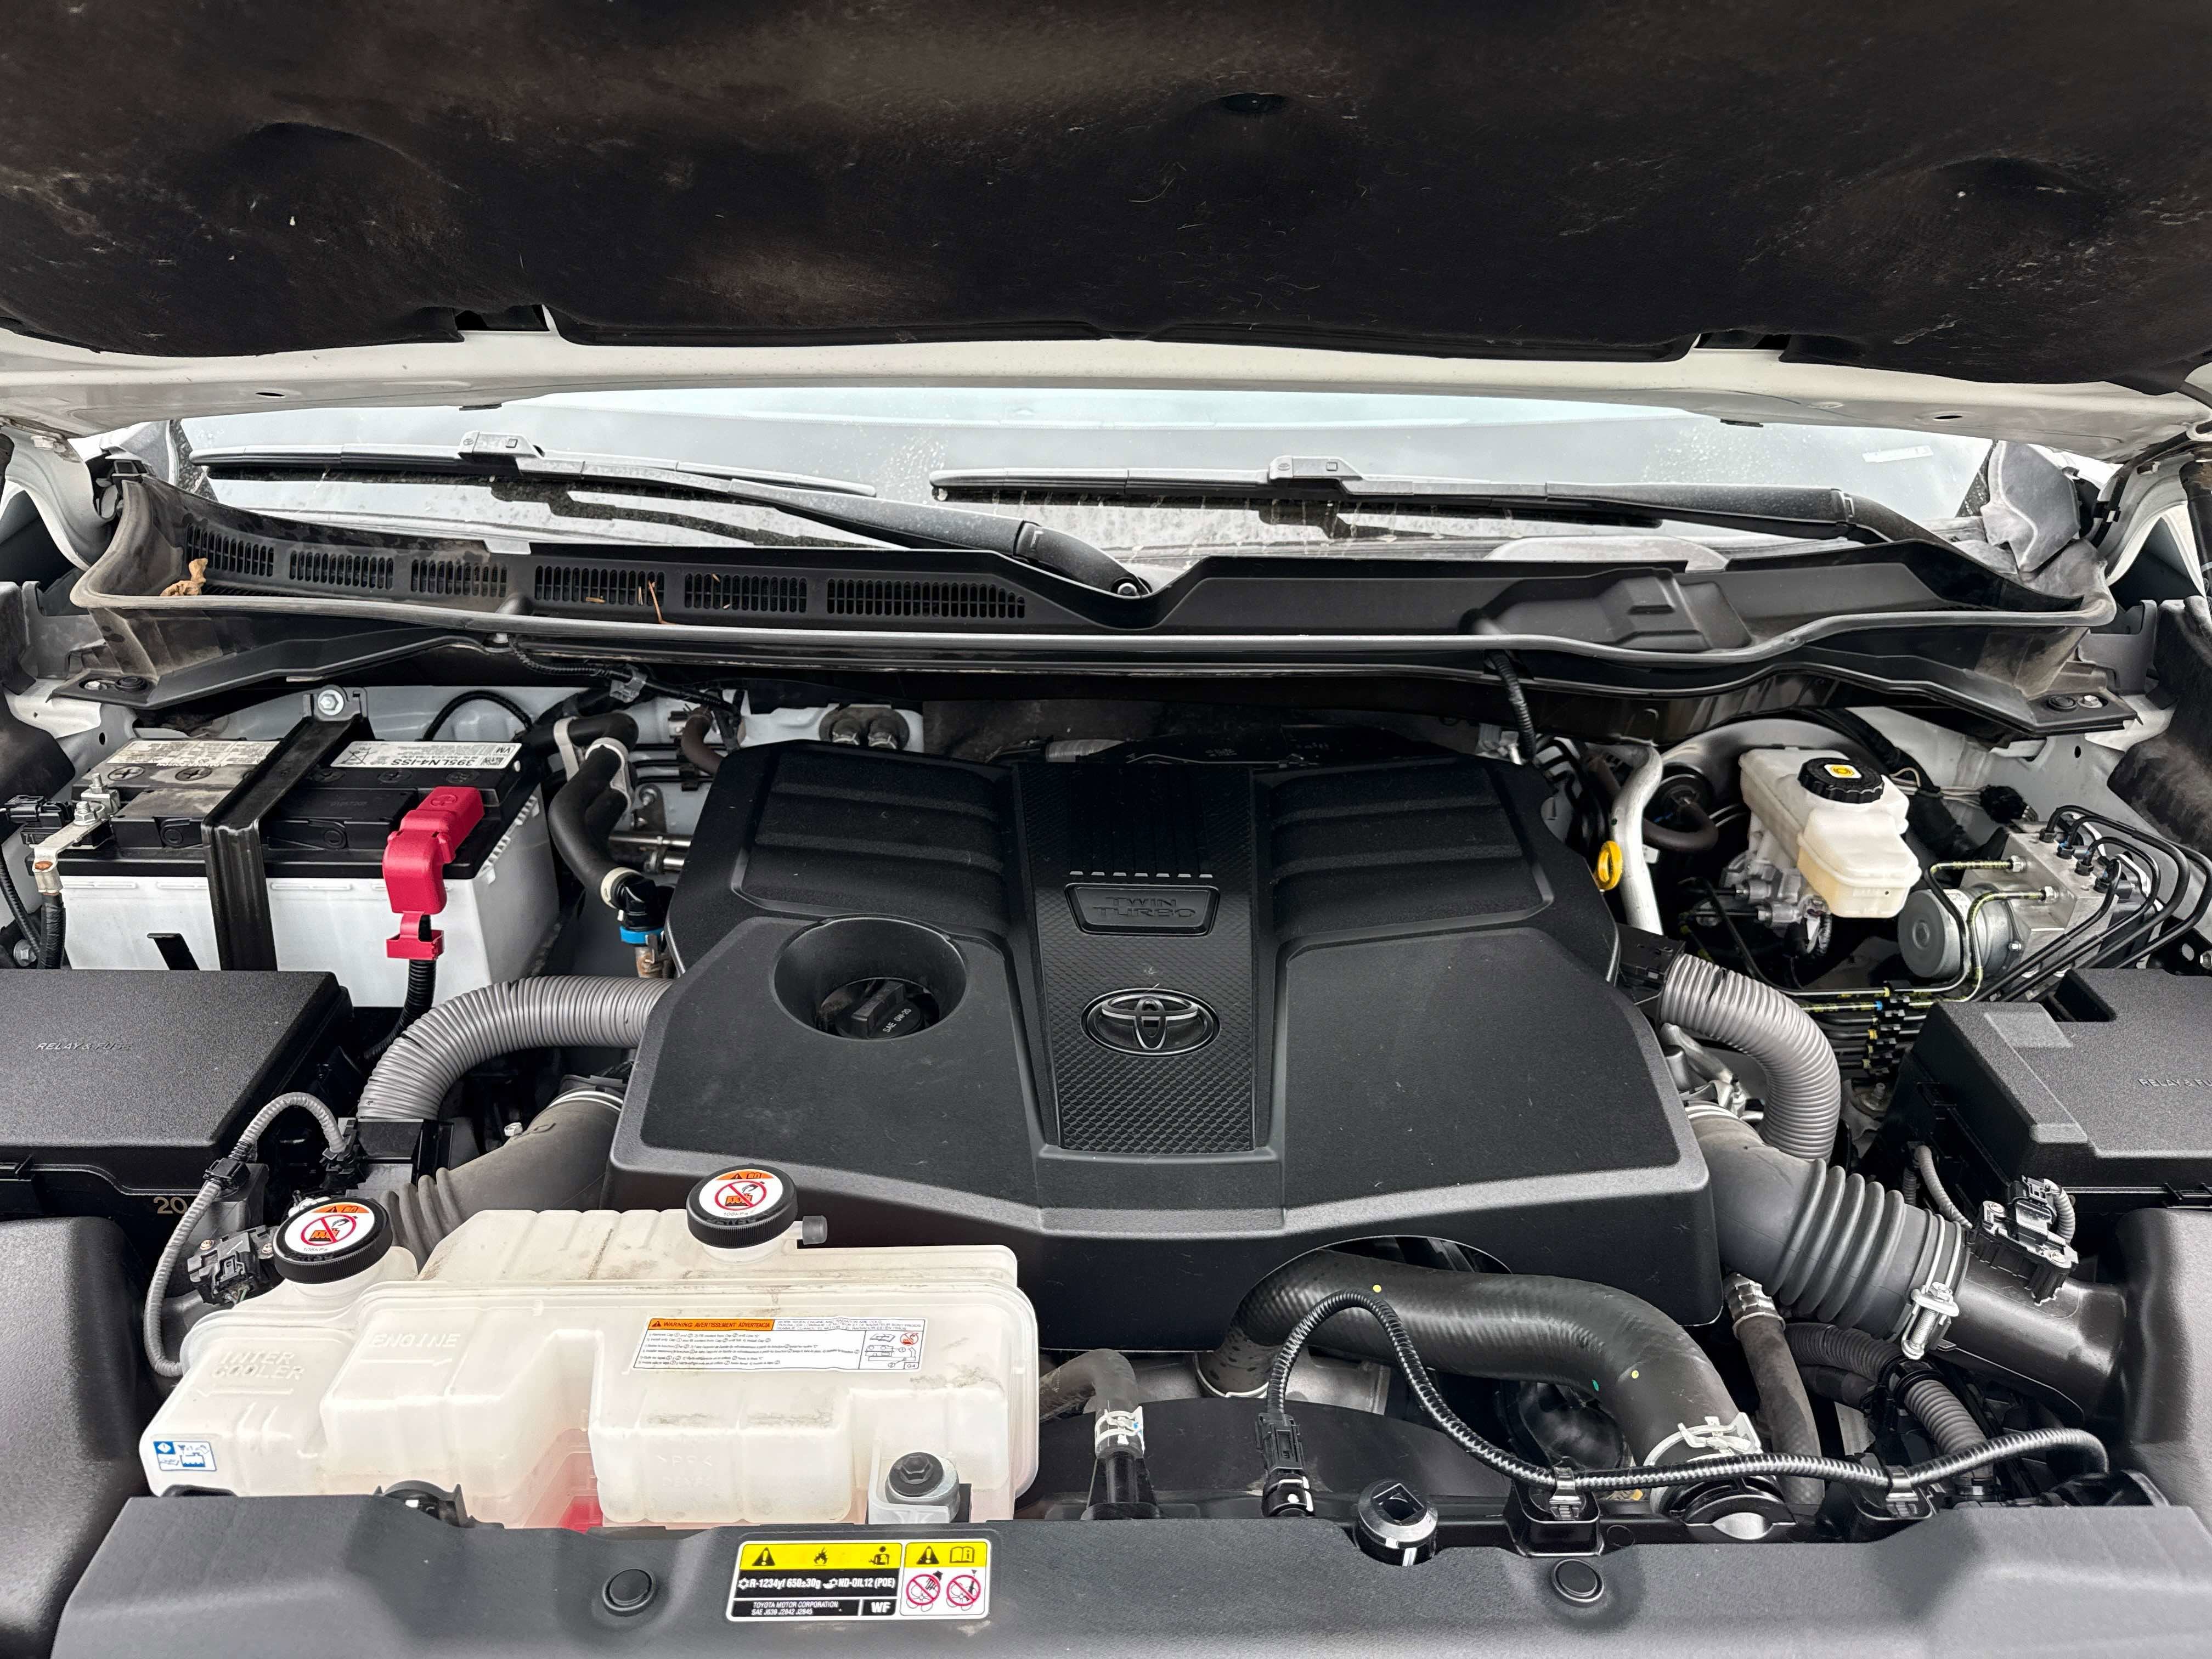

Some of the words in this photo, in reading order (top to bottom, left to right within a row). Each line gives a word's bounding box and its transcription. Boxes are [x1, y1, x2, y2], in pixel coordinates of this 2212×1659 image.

[1104, 896, 1177, 907] TWIN
[1093, 907, 1197, 918] TURBO
[882, 1022, 897, 1033] SAE
[894, 1008, 912, 1022] 0W-20
[369, 1333, 461, 1348] ENGINE
[218, 1350, 296, 1365] INTER
[211, 1364, 305, 1380] COOLER
[749, 1578, 786, 1590] R-1234yf
[787, 1578, 822, 1589] 650±30g
[838, 1578, 873, 1588] ND-OIL12
[874, 1577, 895, 1589] (POE)
[871, 1601, 891, 1613] WF
